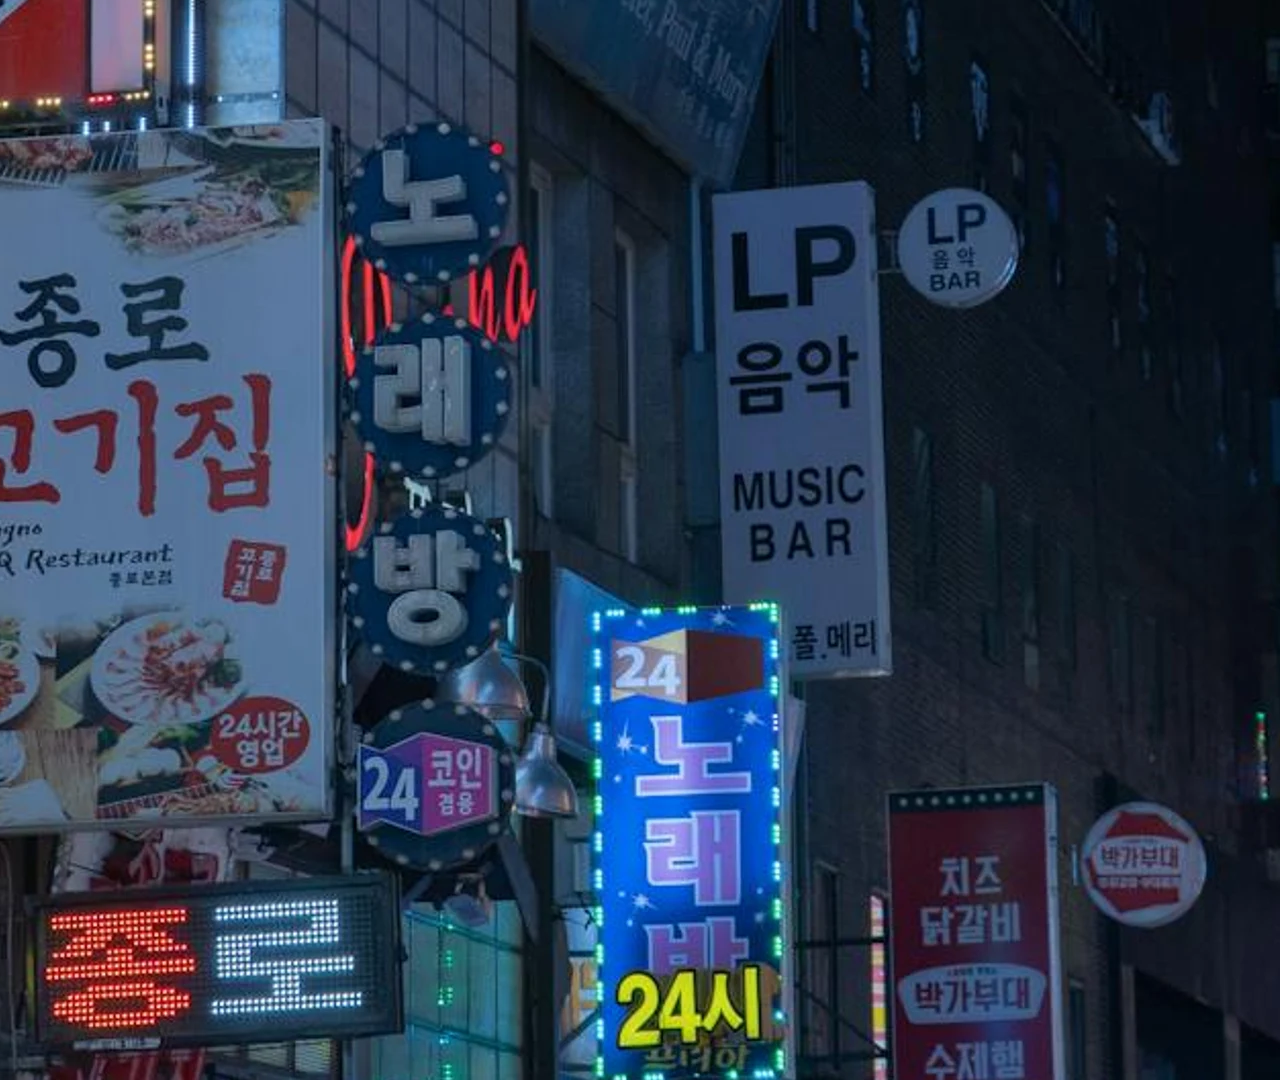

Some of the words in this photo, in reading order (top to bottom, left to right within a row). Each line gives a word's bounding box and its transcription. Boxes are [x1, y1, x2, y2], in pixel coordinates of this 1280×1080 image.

[927, 203, 987, 245] LP
[731, 224, 856, 312] LP
[930, 246, 976, 270] 음악
[929, 269, 981, 293] BAR
[729, 334, 860, 417] 음악
[370, 149, 481, 646] 노래방
[733, 463, 866, 512] MUSIC
[24, 543, 174, 576] Restaurant
[749, 517, 852, 563] BAR
[615, 645, 682, 696] 24
[219, 710, 304, 741] 24시간
[235, 739, 285, 768] 영업
[428, 746, 483, 788] 코인
[362, 756, 420, 821] 24
[938, 854, 1003, 897] 치즈
[1101, 844, 1181, 870] 박가부대
[919, 901, 1022, 946] 닭갈비
[46, 899, 364, 1028] 종로
[615, 963, 763, 1050] 24시
[913, 976, 1031, 1016] 박가부대
[924, 1039, 1026, 1080] 수제햄
